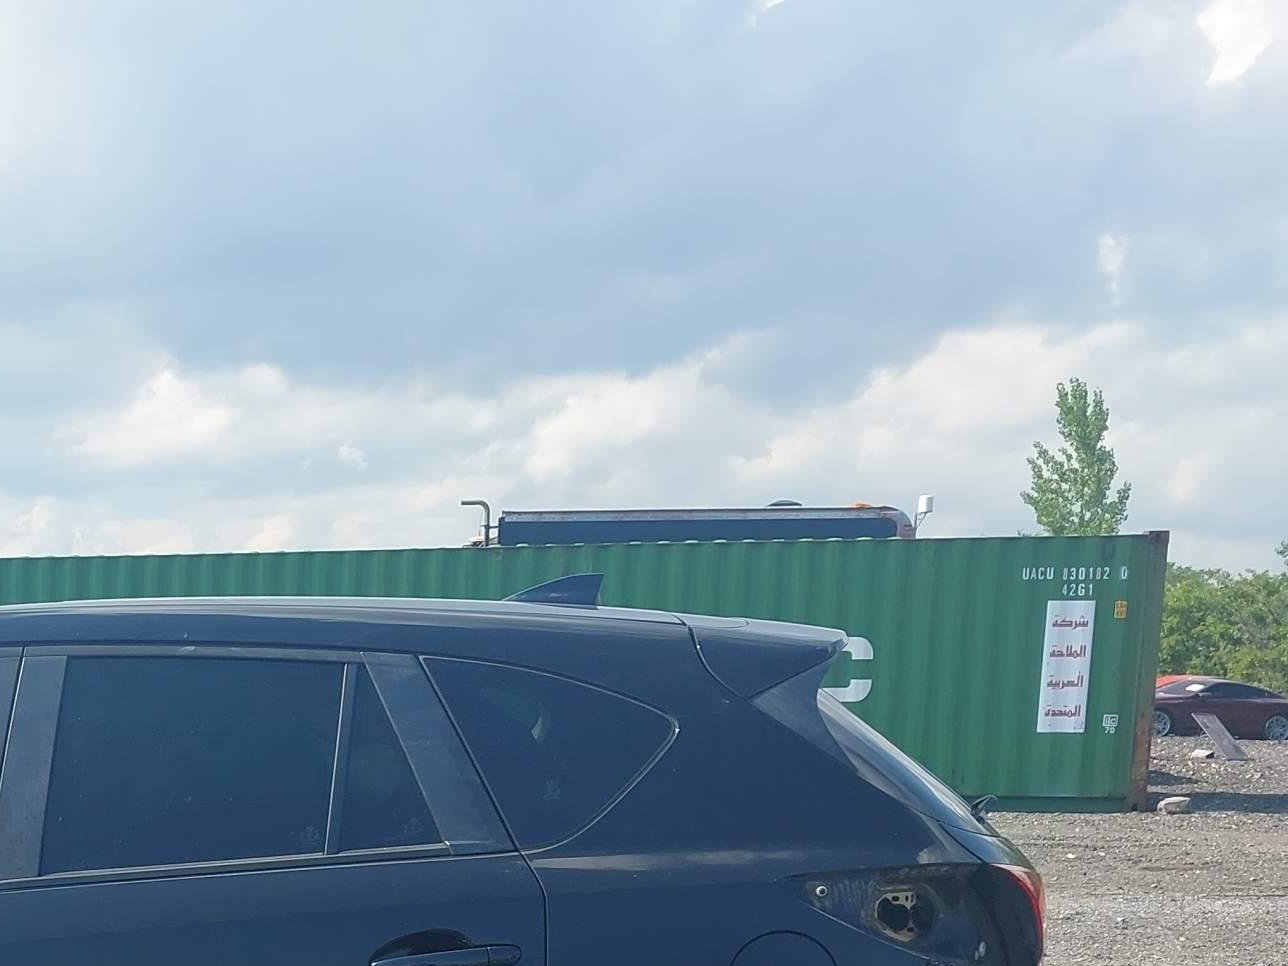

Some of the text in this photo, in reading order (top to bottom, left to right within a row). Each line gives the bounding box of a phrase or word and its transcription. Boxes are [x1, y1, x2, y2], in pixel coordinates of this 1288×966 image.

[1022, 566, 1128, 580] UACU 830182 0
[1062, 584, 1093, 596] 42G1
[1052, 615, 1089, 630] شركة
[1049, 645, 1087, 658] الملاحة
[1047, 672, 1084, 689] العربية
[1044, 704, 1082, 718] المتحدة
